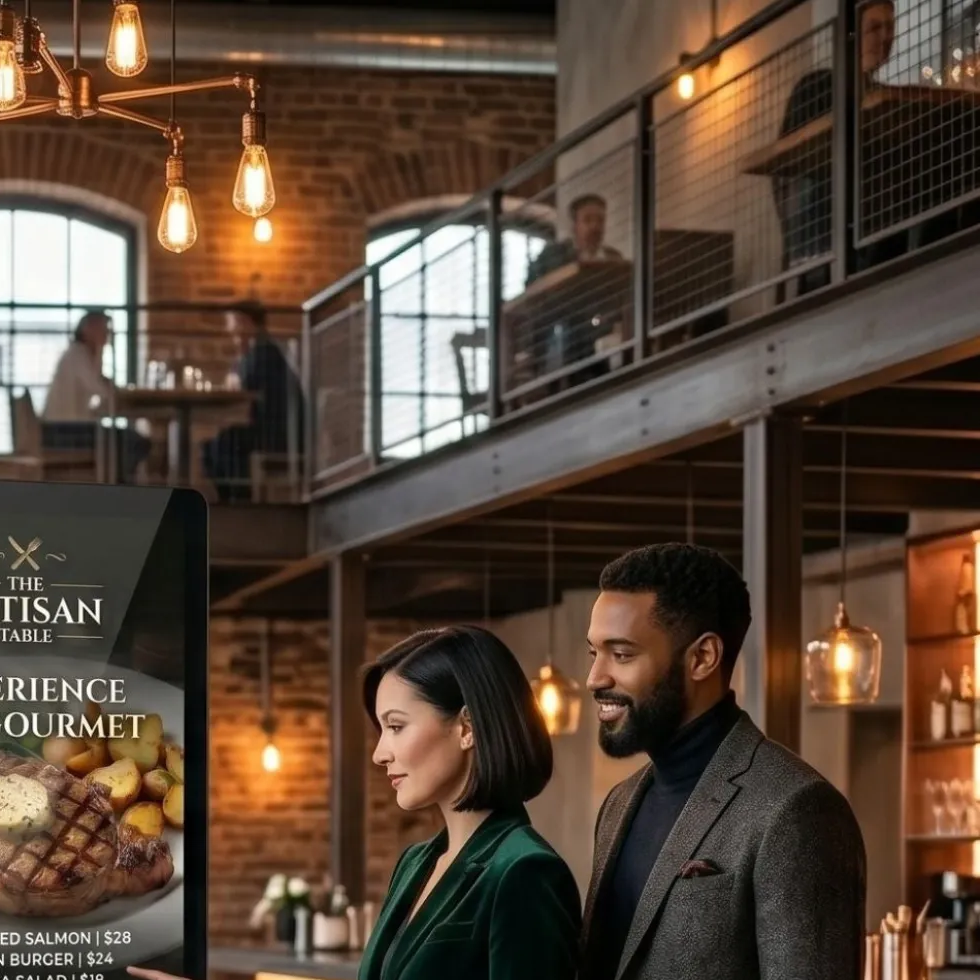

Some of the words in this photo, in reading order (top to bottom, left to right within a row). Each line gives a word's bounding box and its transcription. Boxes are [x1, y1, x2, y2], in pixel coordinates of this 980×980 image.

[6, 576, 44, 592] THE
[25, 931, 91, 946] SALMON
[104, 930, 132, 946] $28
[10, 952, 74, 967] BURGER
[86, 951, 114, 966] $24
